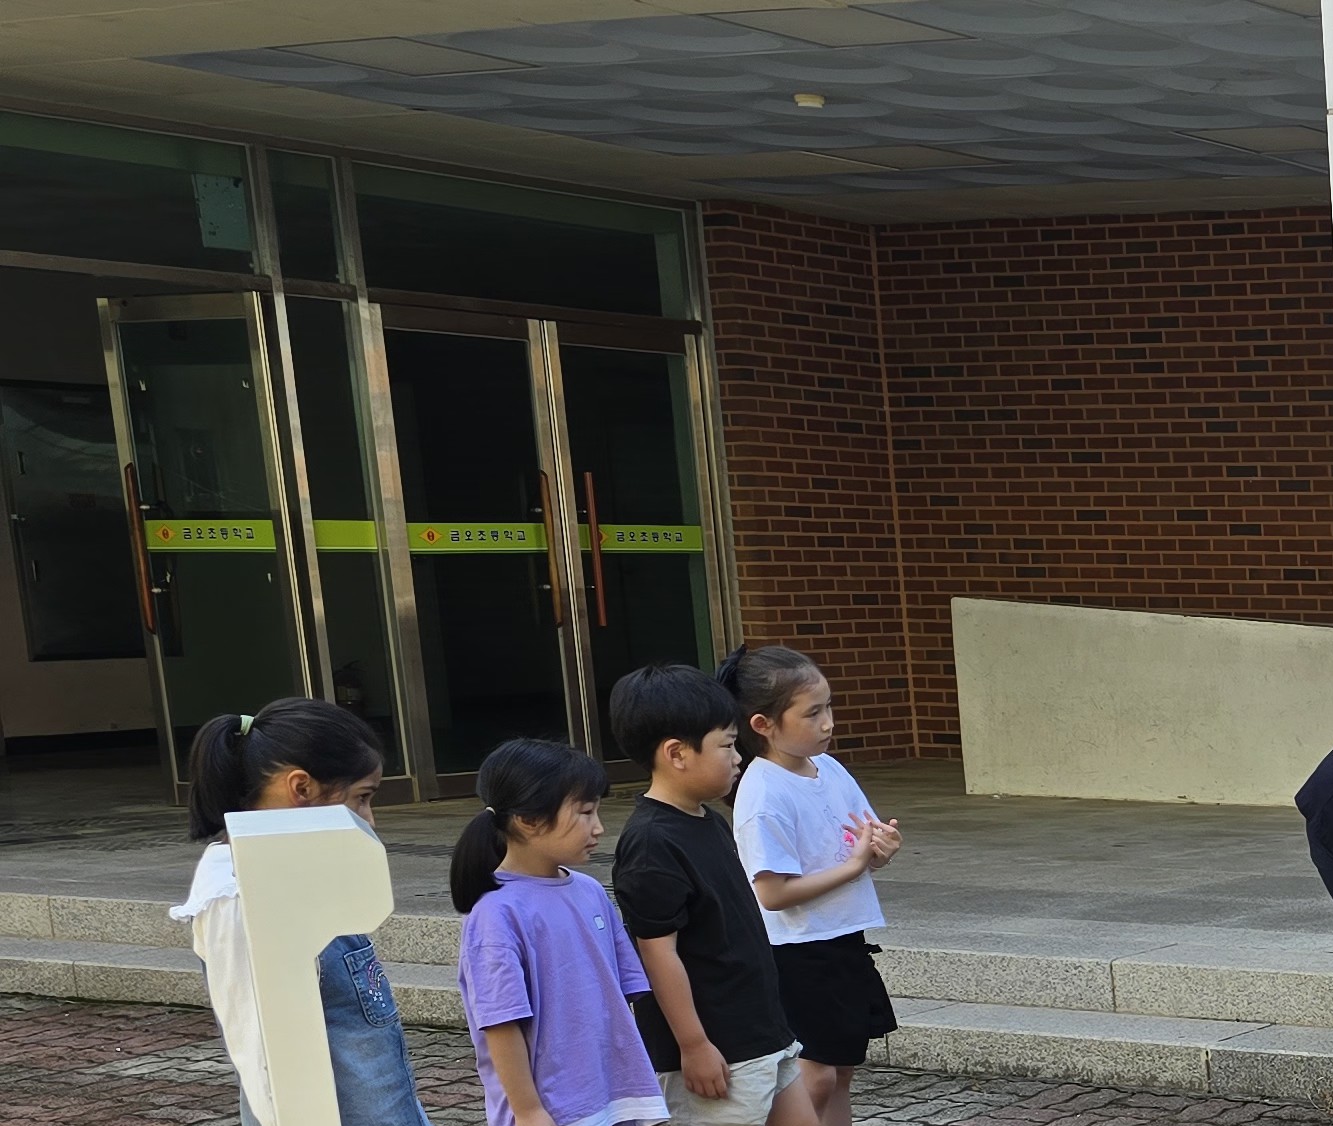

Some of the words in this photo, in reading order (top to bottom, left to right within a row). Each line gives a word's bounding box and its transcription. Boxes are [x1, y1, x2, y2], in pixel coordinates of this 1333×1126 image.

[182, 527, 255, 541] 금오초등학교
[449, 530, 527, 542] 금오초등학교
[615, 531, 684, 543] 금오초등학교
